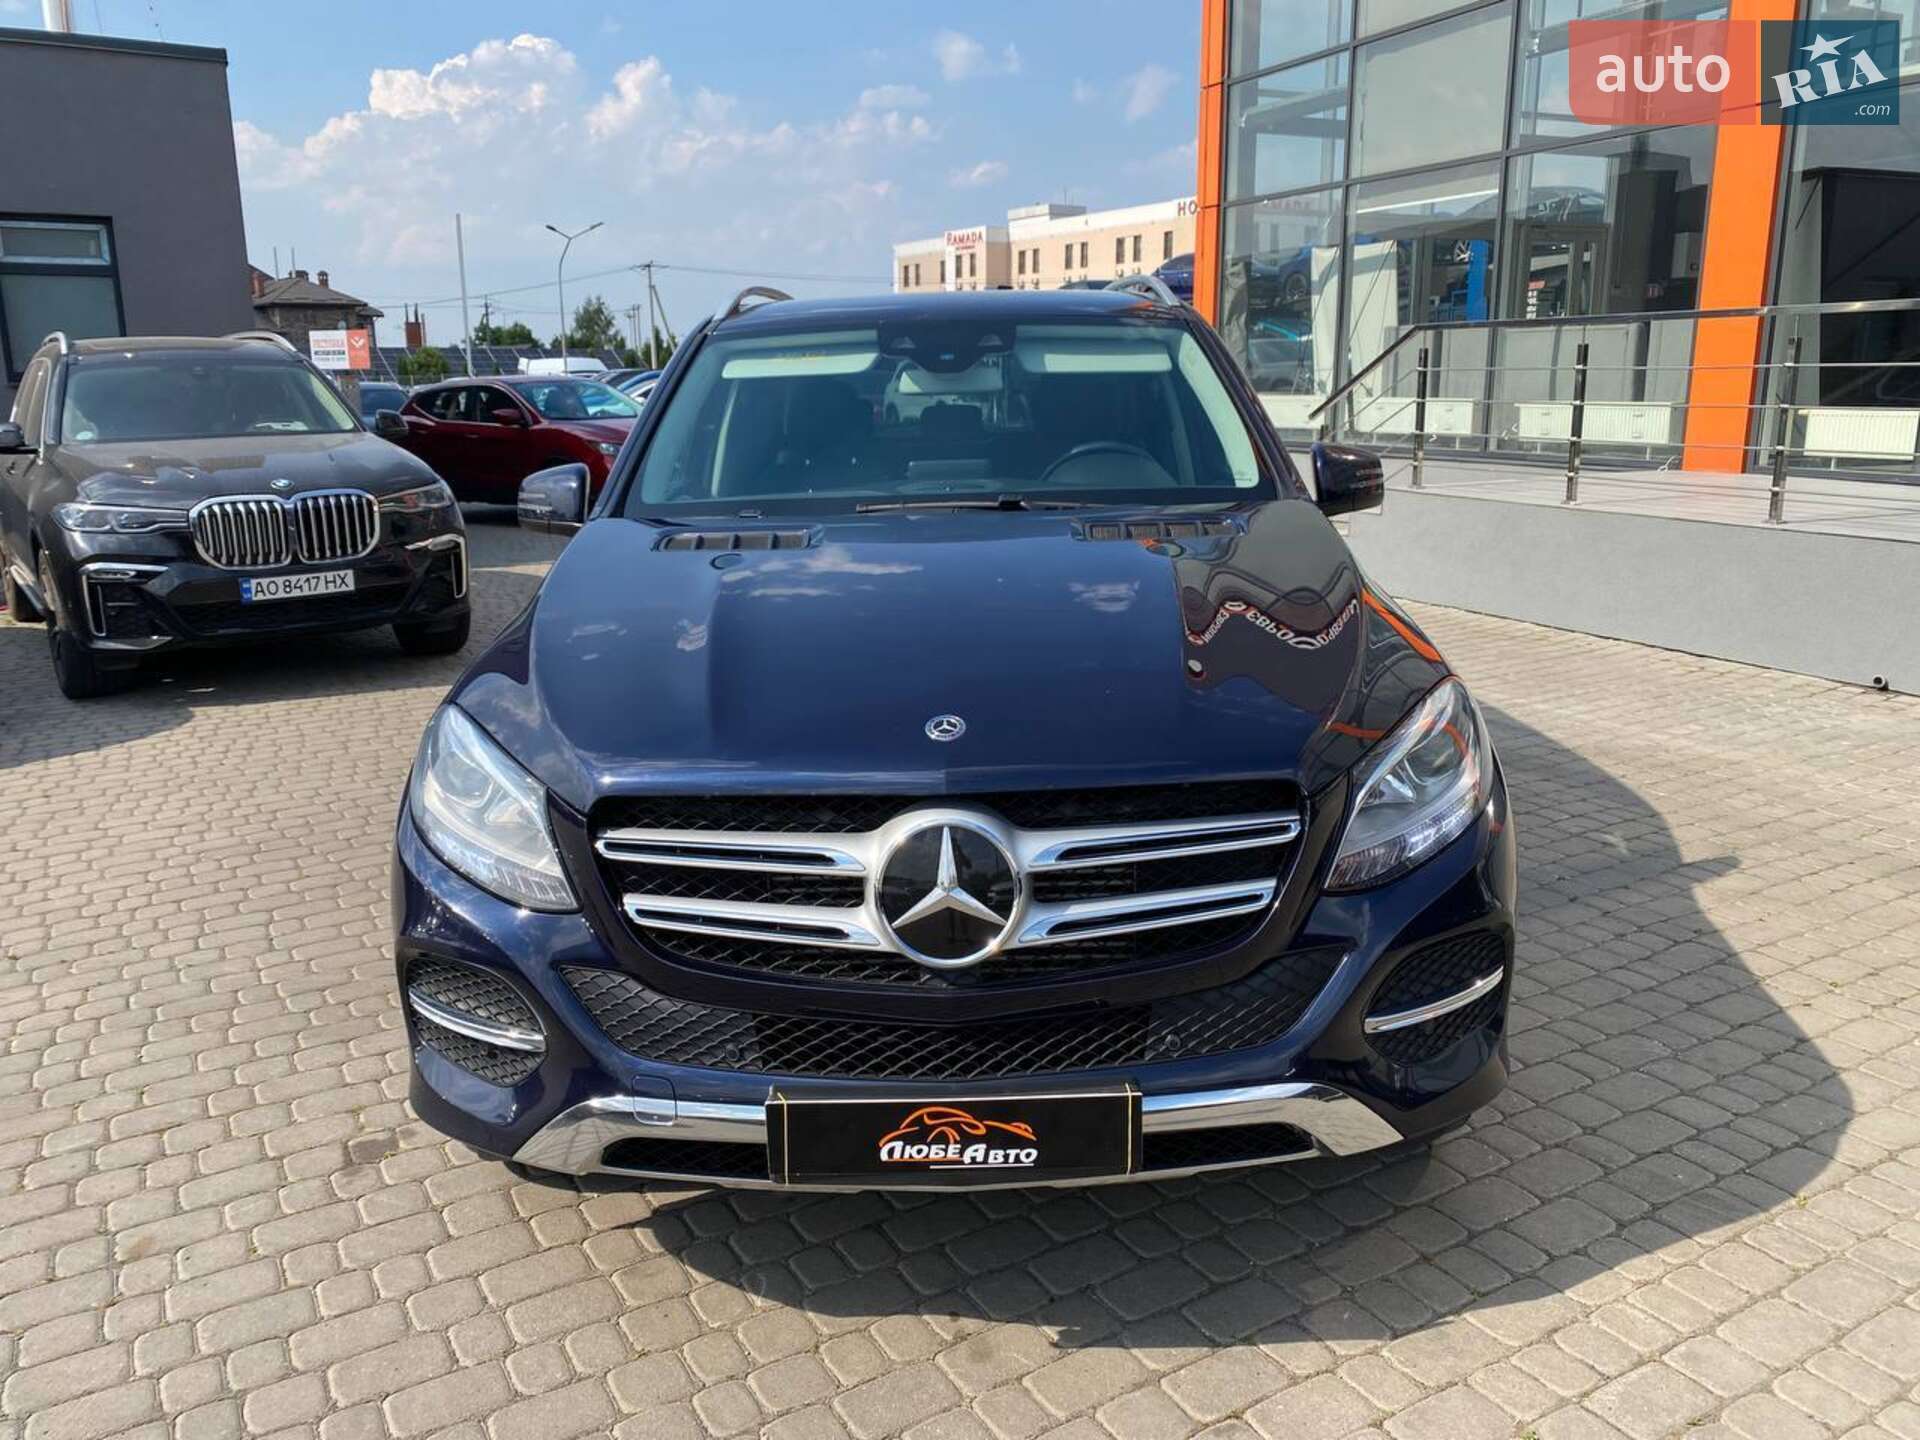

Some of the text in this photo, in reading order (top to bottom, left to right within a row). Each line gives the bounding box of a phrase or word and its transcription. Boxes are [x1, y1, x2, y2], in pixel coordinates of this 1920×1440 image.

[945, 230, 983, 247] RAMADA
[254, 572, 350, 598] AO 8417 HX
